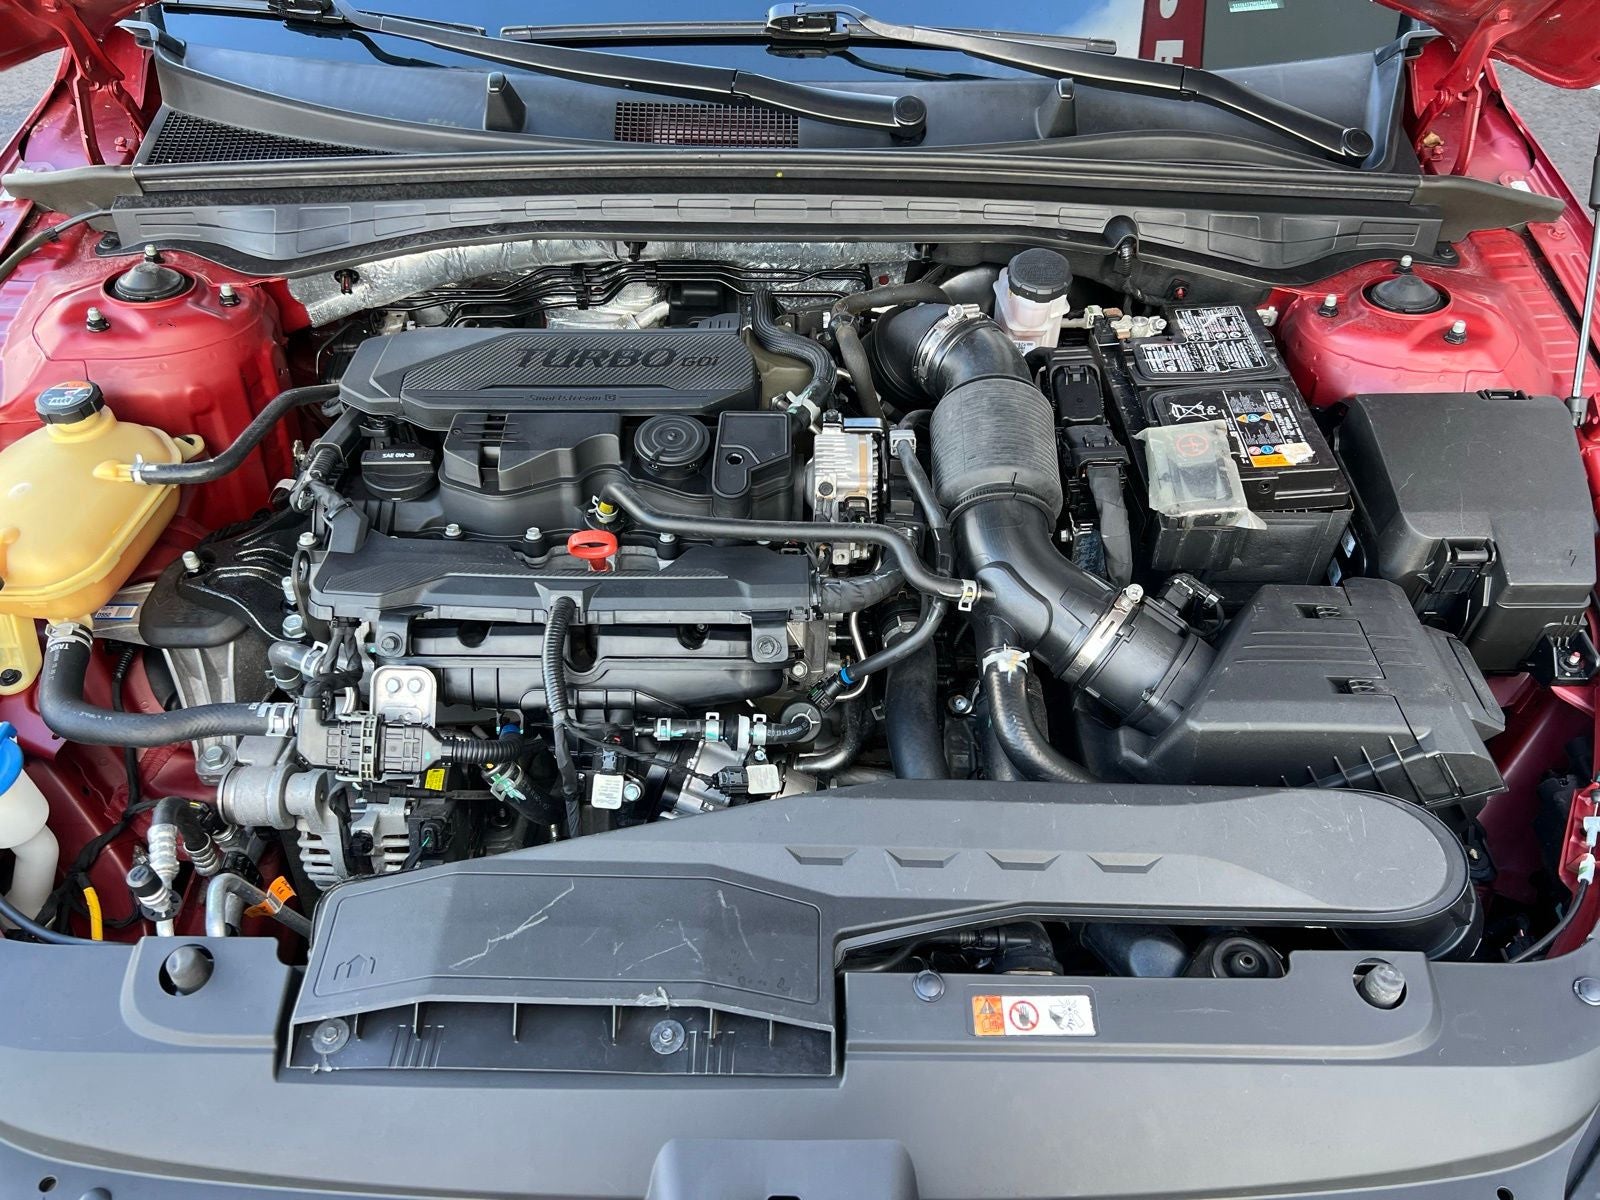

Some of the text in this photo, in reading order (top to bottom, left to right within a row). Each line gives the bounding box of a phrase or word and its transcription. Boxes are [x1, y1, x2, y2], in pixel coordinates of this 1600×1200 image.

[516, 349, 720, 369] TURBO GDi
[529, 394, 602, 402] Smartstream
[49, 643, 70, 652] TANK
